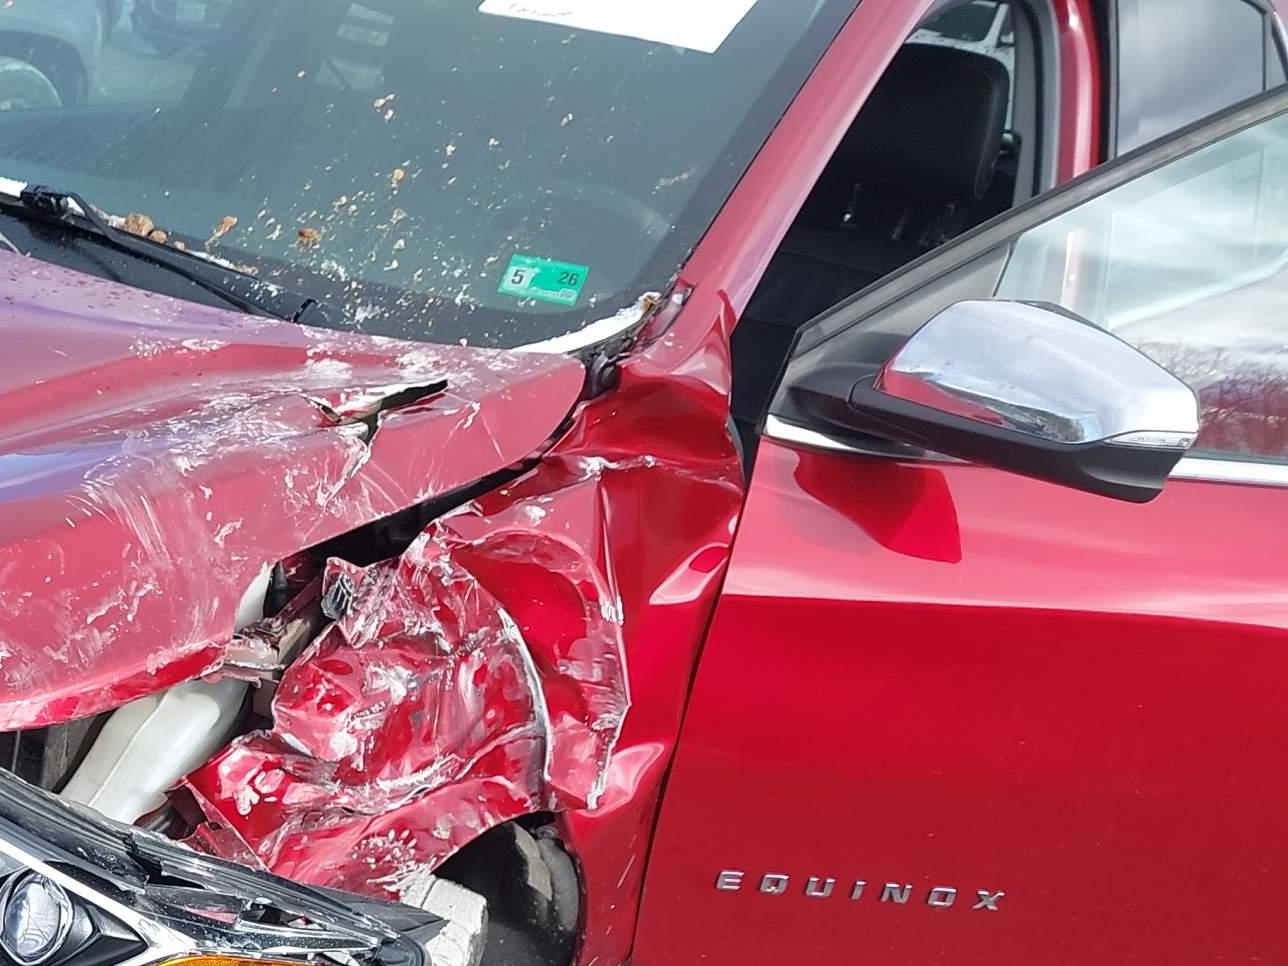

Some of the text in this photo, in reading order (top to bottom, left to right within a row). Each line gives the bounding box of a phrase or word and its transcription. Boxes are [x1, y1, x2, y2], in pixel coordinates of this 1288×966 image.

[511, 269, 580, 287] 5 26
[715, 870, 1005, 911] EQUINOX
